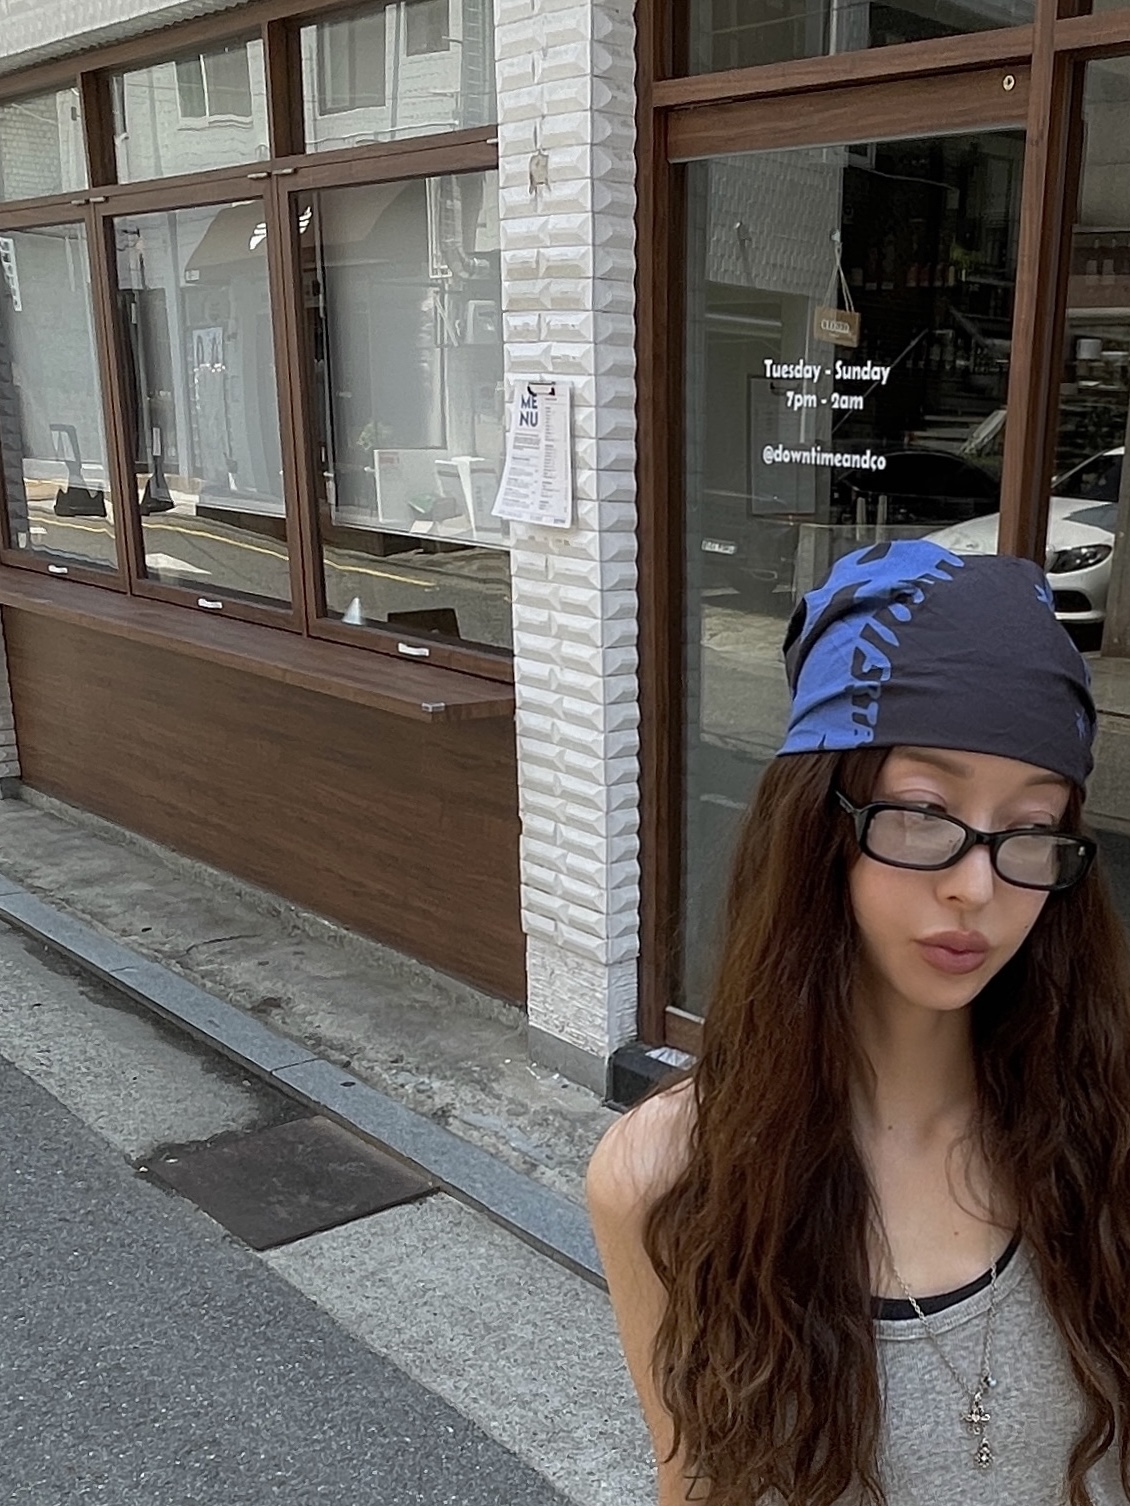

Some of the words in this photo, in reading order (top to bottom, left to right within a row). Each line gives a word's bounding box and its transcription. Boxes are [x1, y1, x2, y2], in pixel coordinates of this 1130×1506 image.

[764, 359, 821, 383] Tuesday
[835, 360, 891, 385] Sunday
[520, 395, 538, 410] ME
[786, 391, 817, 411] 7pm
[831, 393, 864, 410] 2am
[519, 411, 539, 427] NU
